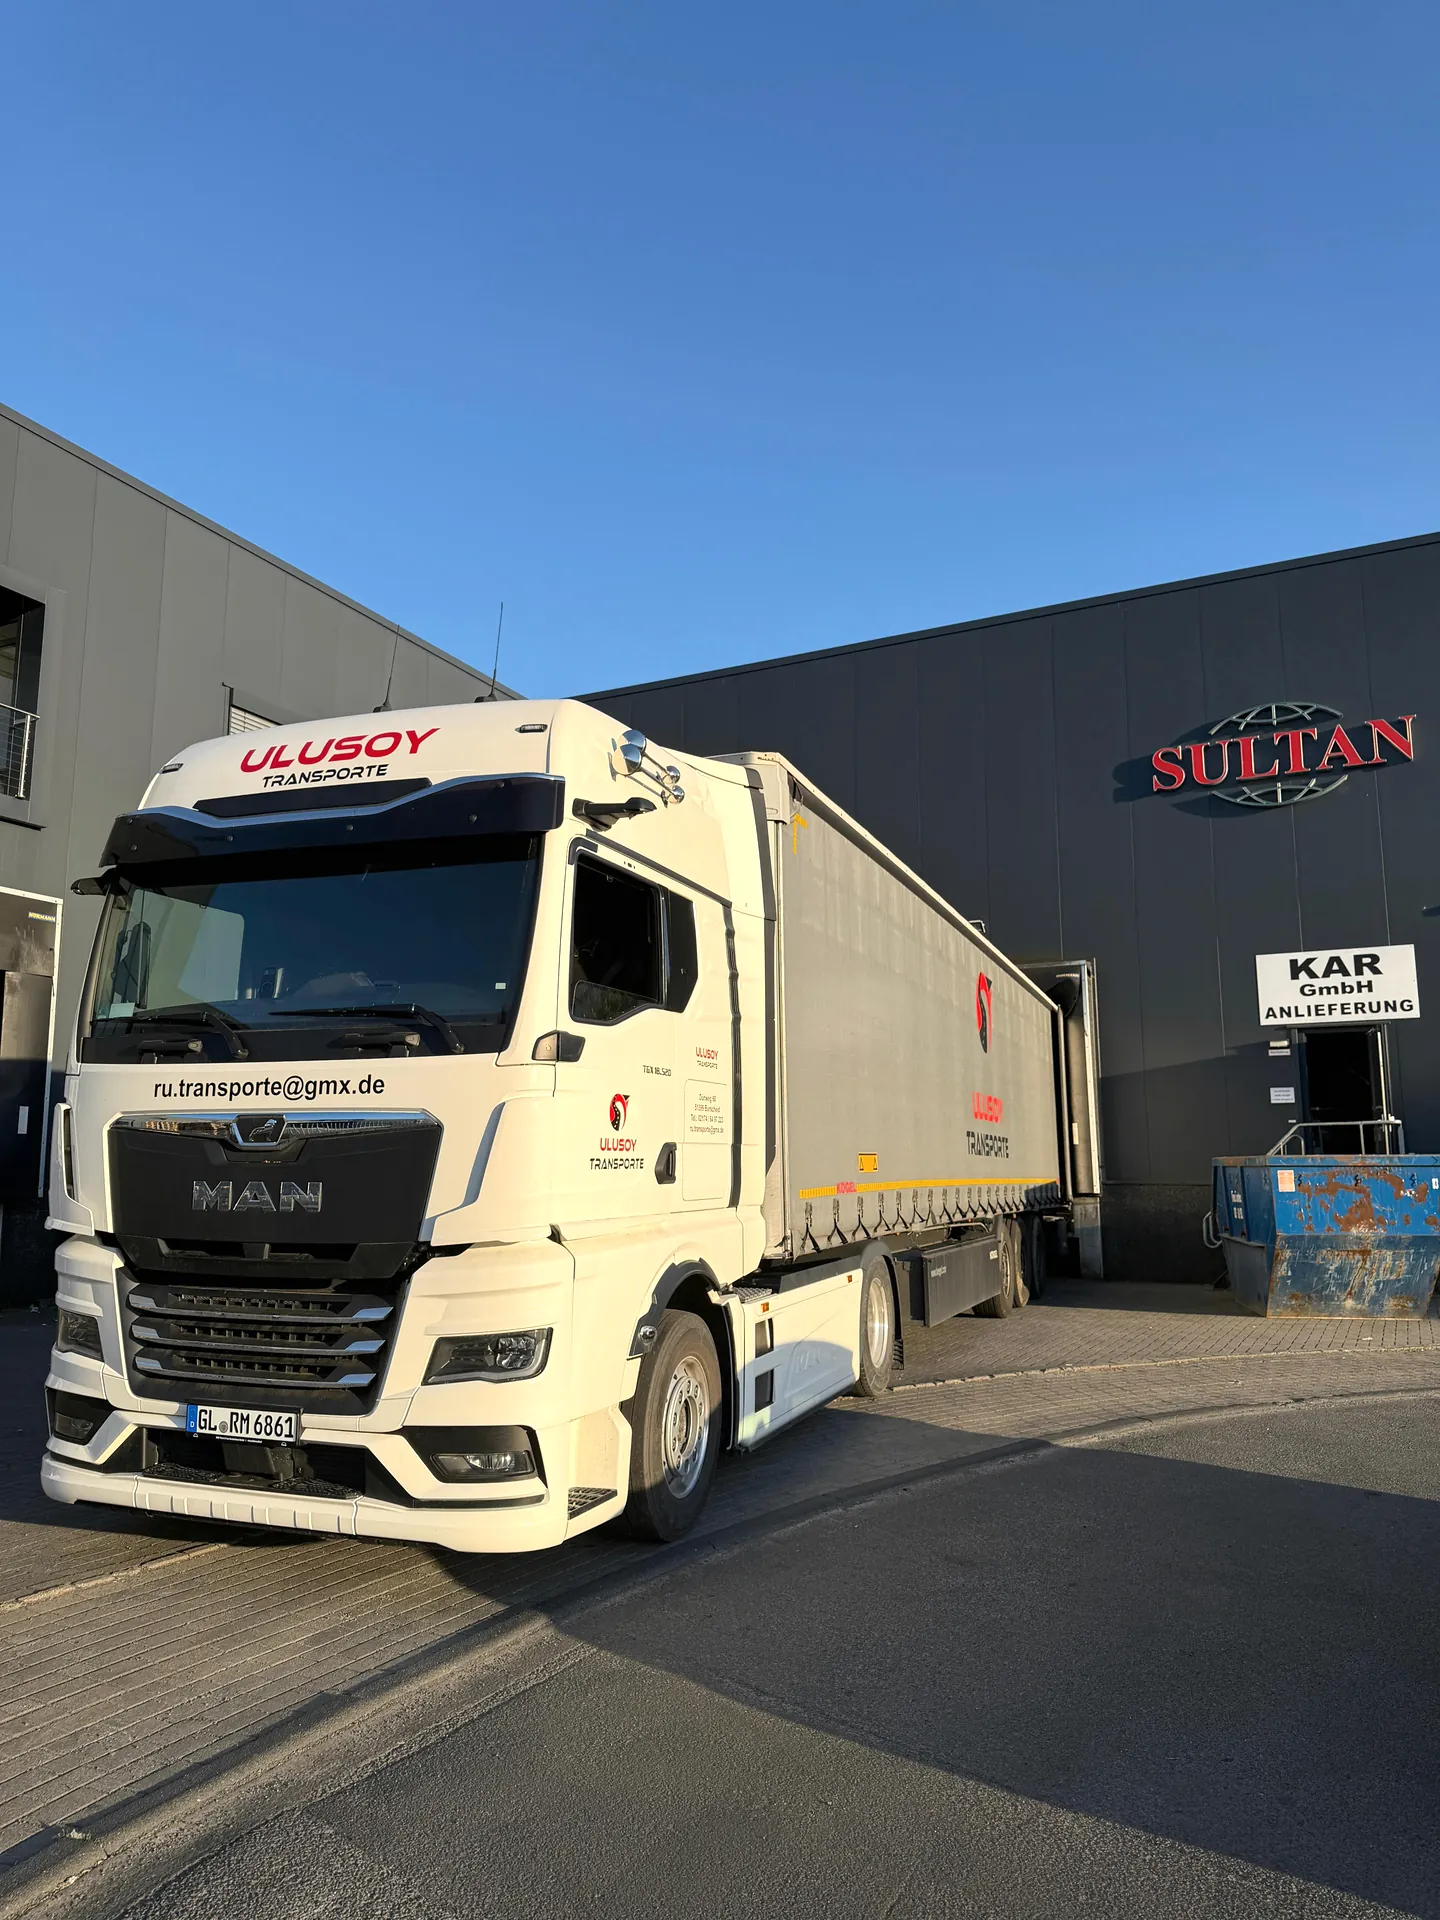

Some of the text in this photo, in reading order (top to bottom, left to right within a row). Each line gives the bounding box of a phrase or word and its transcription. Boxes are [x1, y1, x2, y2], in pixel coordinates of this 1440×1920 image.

[240, 728, 441, 772] ULUSOY
[1151, 714, 1417, 792] SULTAN
[262, 764, 389, 788] TRANSPORTE
[1289, 953, 1383, 980] KAR
[1299, 980, 1374, 997] GmbH
[1264, 999, 1414, 1020] ANLIEFERUNG
[695, 1046, 718, 1060] ULUSOY
[154, 1074, 385, 1101] ru.transporte@gmx.de
[971, 1090, 1003, 1124] ULUSOY
[600, 1138, 637, 1152] ULUSOY
[966, 1130, 1009, 1158] TRANSPORTE
[590, 1158, 644, 1170] TRANSPORTE
[192, 1181, 323, 1212] MAN
[198, 1409, 294, 1438] GL RM 6861
